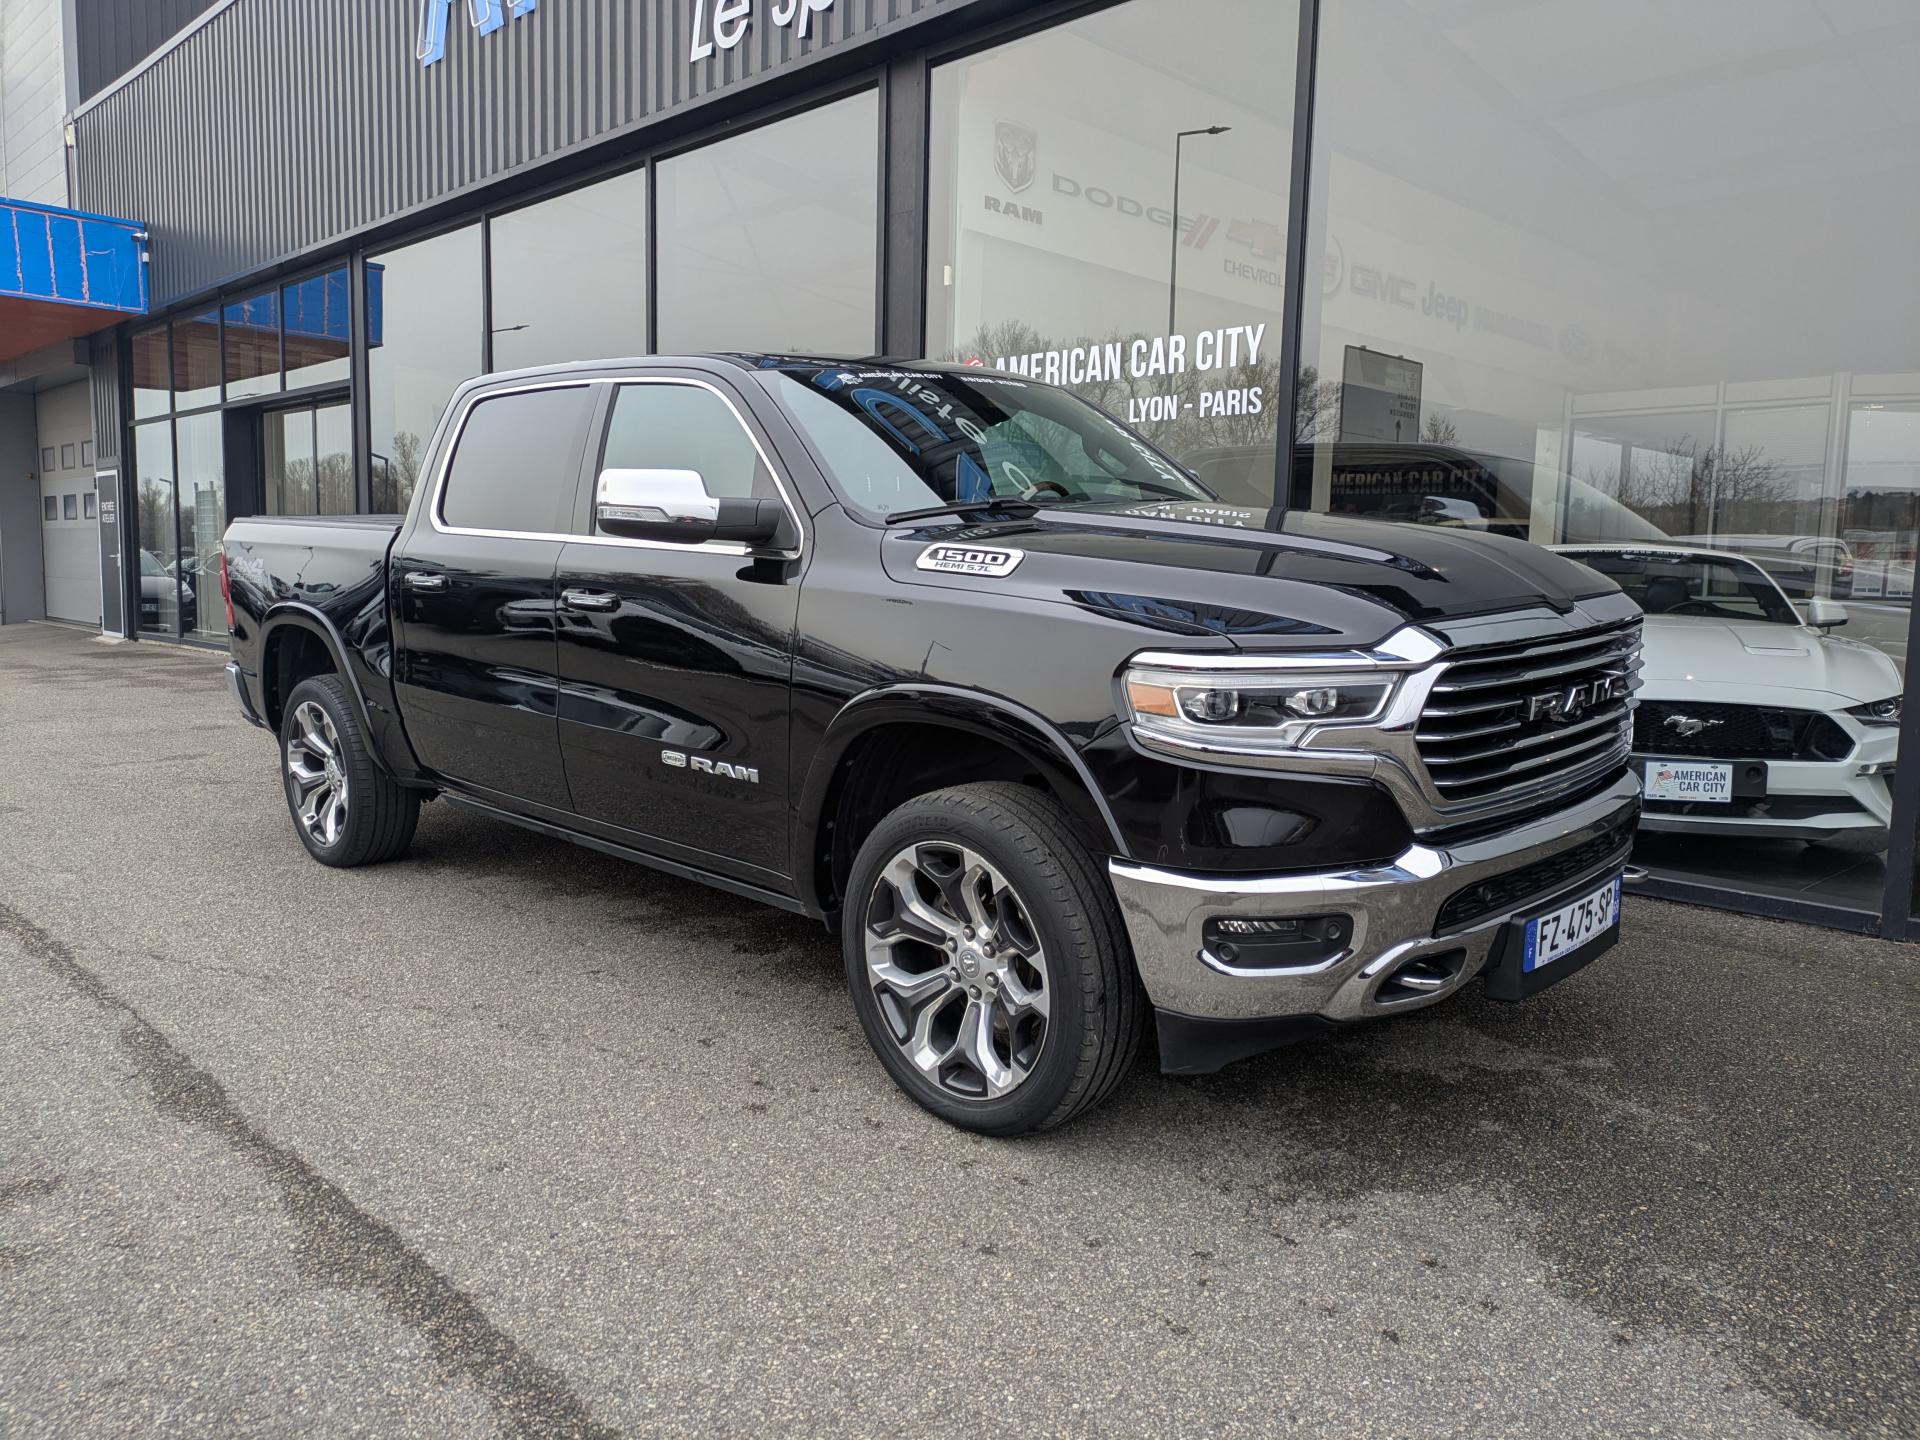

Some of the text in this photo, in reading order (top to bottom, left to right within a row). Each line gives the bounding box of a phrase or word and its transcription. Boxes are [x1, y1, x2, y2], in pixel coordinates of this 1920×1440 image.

[984, 194, 1043, 225] RAM
[1052, 174, 1198, 233] DODGE
[1350, 263, 1416, 311] GMC
[1421, 279, 1469, 333] Jeep
[1130, 334, 1186, 378] CAR
[1195, 323, 1265, 372] CITY
[1128, 394, 1178, 424] LYON
[1199, 386, 1263, 418] PARIS
[934, 561, 992, 573] HEMI 5.7L
[936, 549, 1006, 564] 1500
[1529, 676, 1617, 722] RAM
[690, 756, 759, 784] RAM
[1673, 770, 1726, 782] AMERICAN
[1680, 781, 1726, 793] CAR CITY
[1538, 887, 1613, 957] FZ-475-SP
